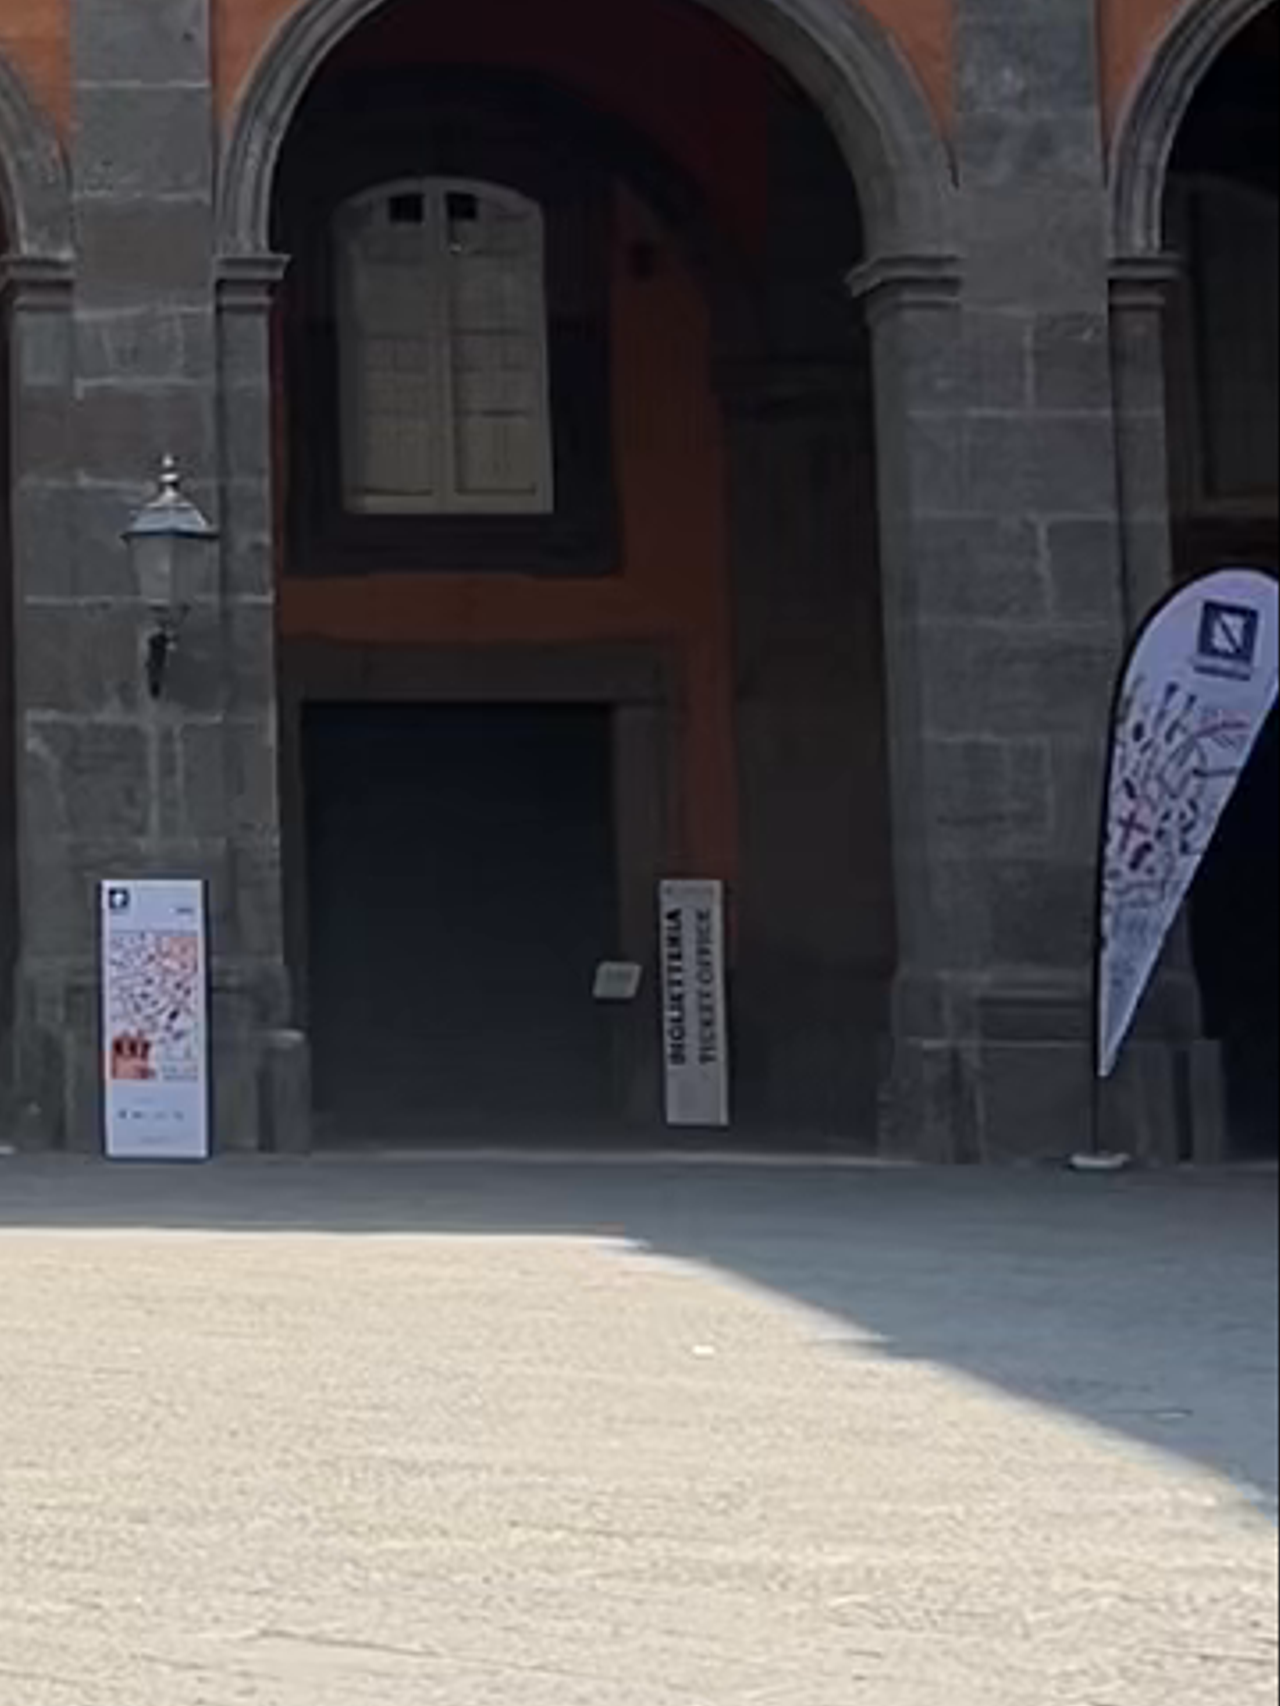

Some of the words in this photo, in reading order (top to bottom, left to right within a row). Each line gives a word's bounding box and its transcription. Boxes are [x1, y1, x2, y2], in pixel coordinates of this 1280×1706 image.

[695, 909, 714, 985] OFFICE
[666, 909, 686, 1065] BIGLIETTERIA
[698, 991, 717, 1065] TICKET
